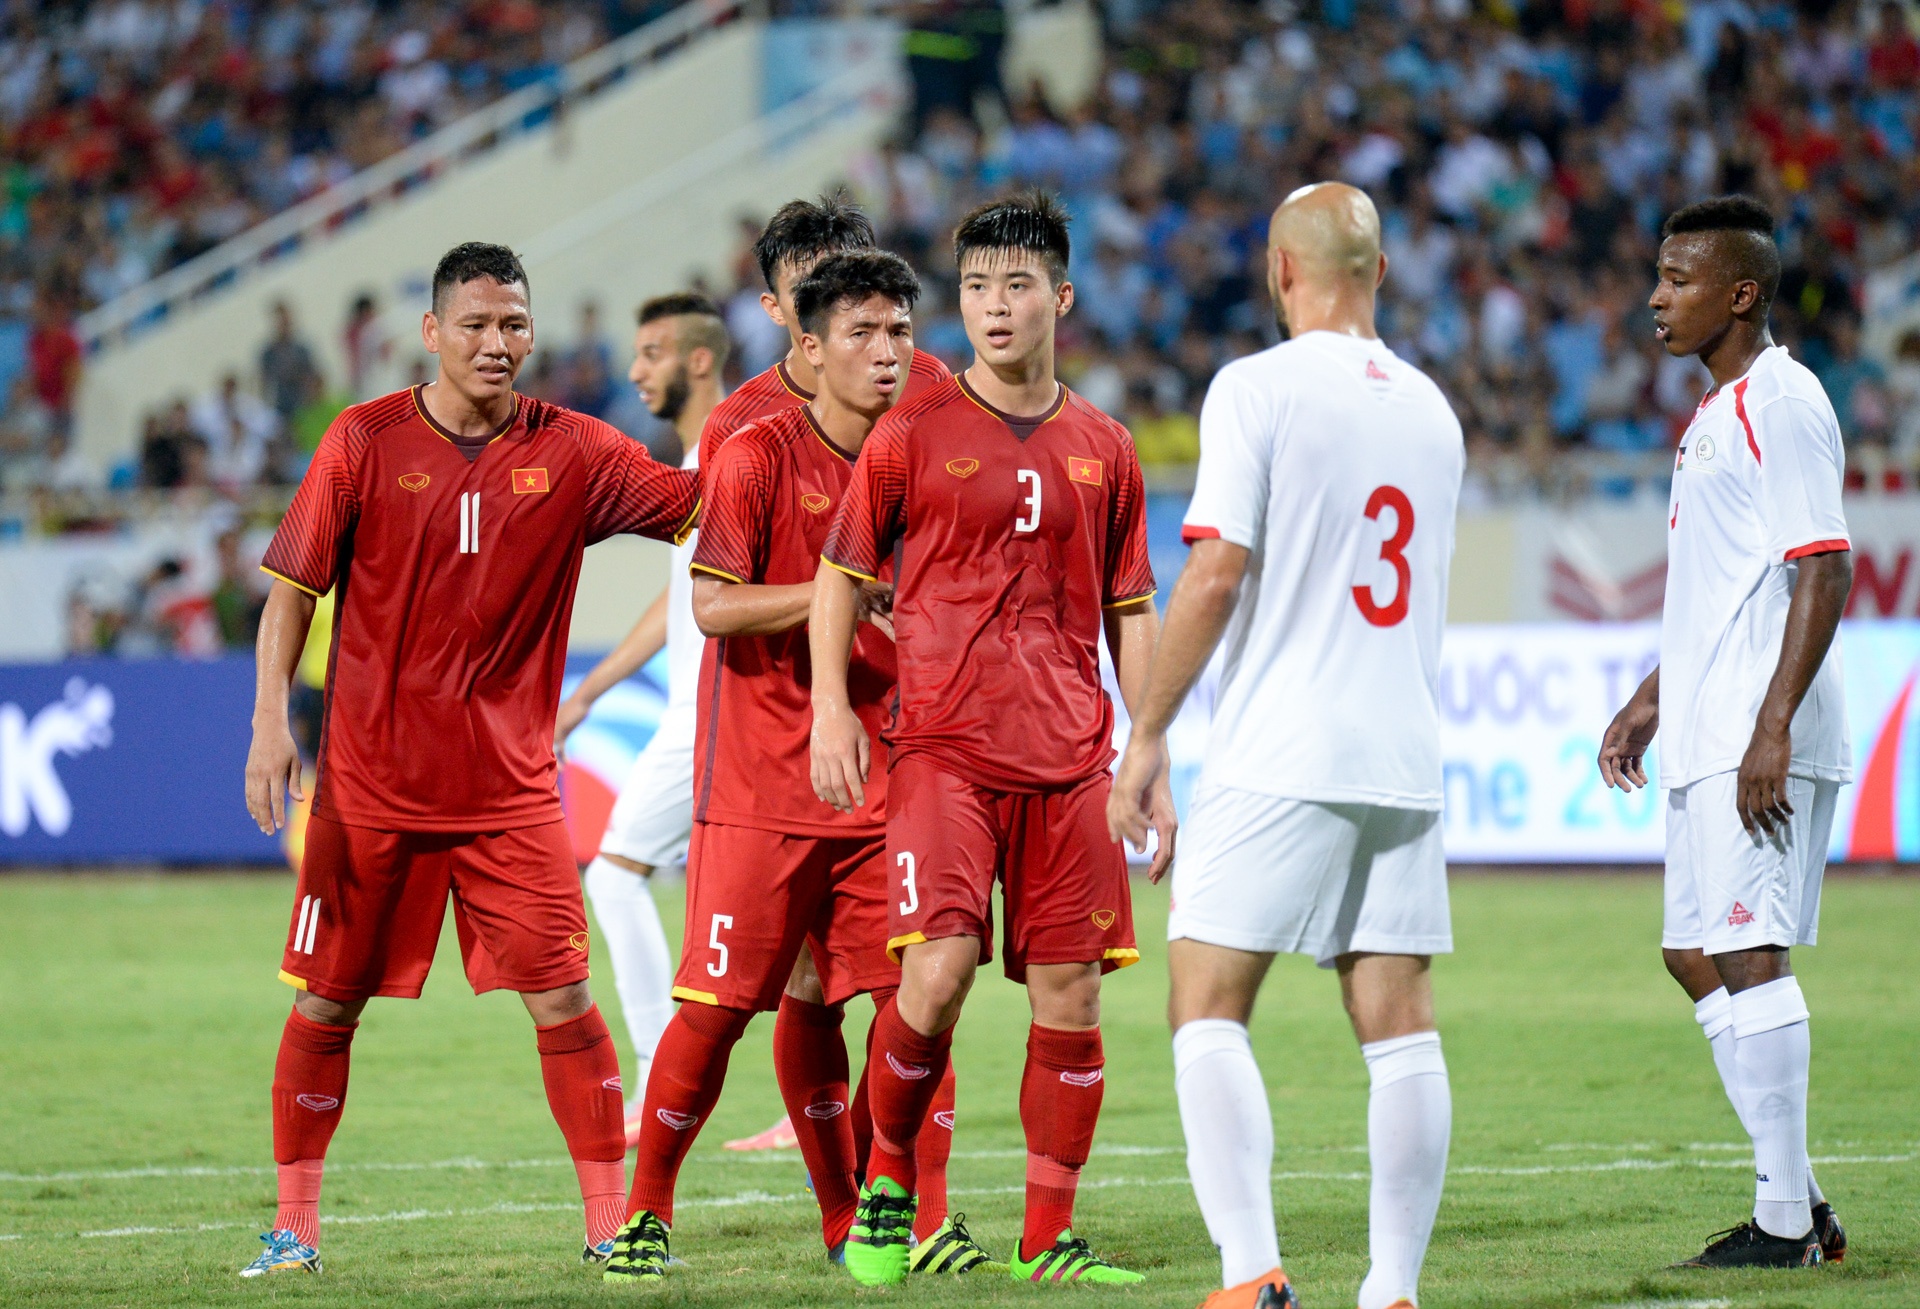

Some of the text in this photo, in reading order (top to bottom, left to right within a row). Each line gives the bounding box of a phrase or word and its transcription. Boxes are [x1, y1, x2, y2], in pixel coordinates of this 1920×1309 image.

[459, 491, 481, 554] 11
[1015, 468, 1042, 533] 3
[1351, 485, 1415, 628] 3
[896, 850, 919, 917] 3
[293, 894, 322, 956] 11
[706, 913, 734, 978] 5
[1727, 911, 1756, 927] PEAK
